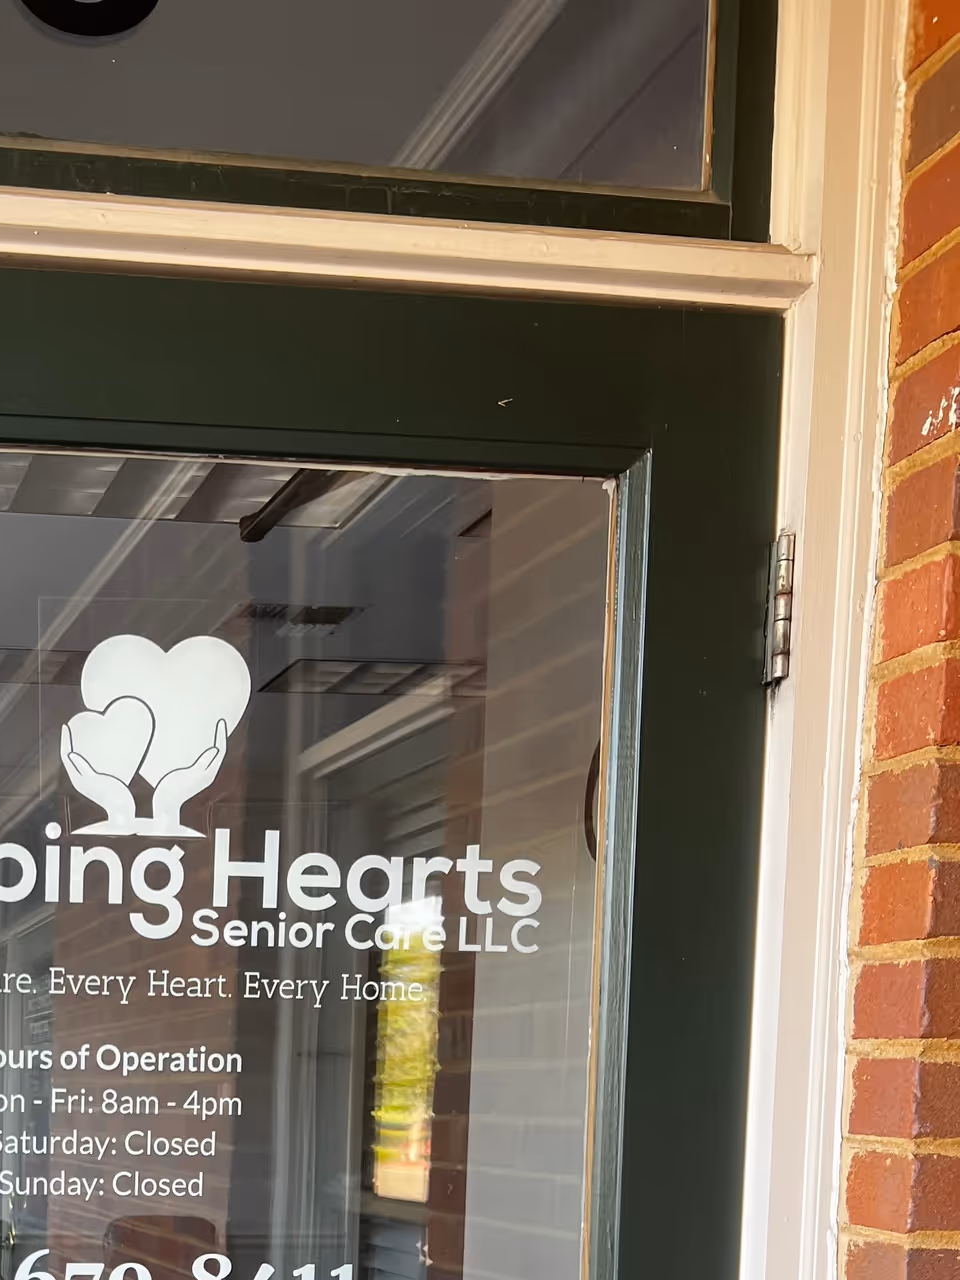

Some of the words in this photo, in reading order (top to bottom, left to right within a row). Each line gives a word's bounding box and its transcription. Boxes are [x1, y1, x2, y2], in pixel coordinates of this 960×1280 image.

[212, 828, 542, 917] Hearts
[190, 908, 335, 949] Senior
[344, 913, 447, 950] Care
[458, 916, 541, 954] LLC
[48, 967, 136, 1004] Every
[147, 969, 232, 999] Heart.
[243, 972, 330, 1008] Every
[340, 974, 428, 1001] Home.
[59, 1044, 90, 1070] of
[95, 1044, 243, 1076] Operation
[51, 1088, 94, 1114] Fri:
[101, 1089, 159, 1115] 8am
[182, 1090, 243, 1121] 4pm
[124, 1130, 217, 1157] Closed
[112, 1171, 204, 1197] Closed
